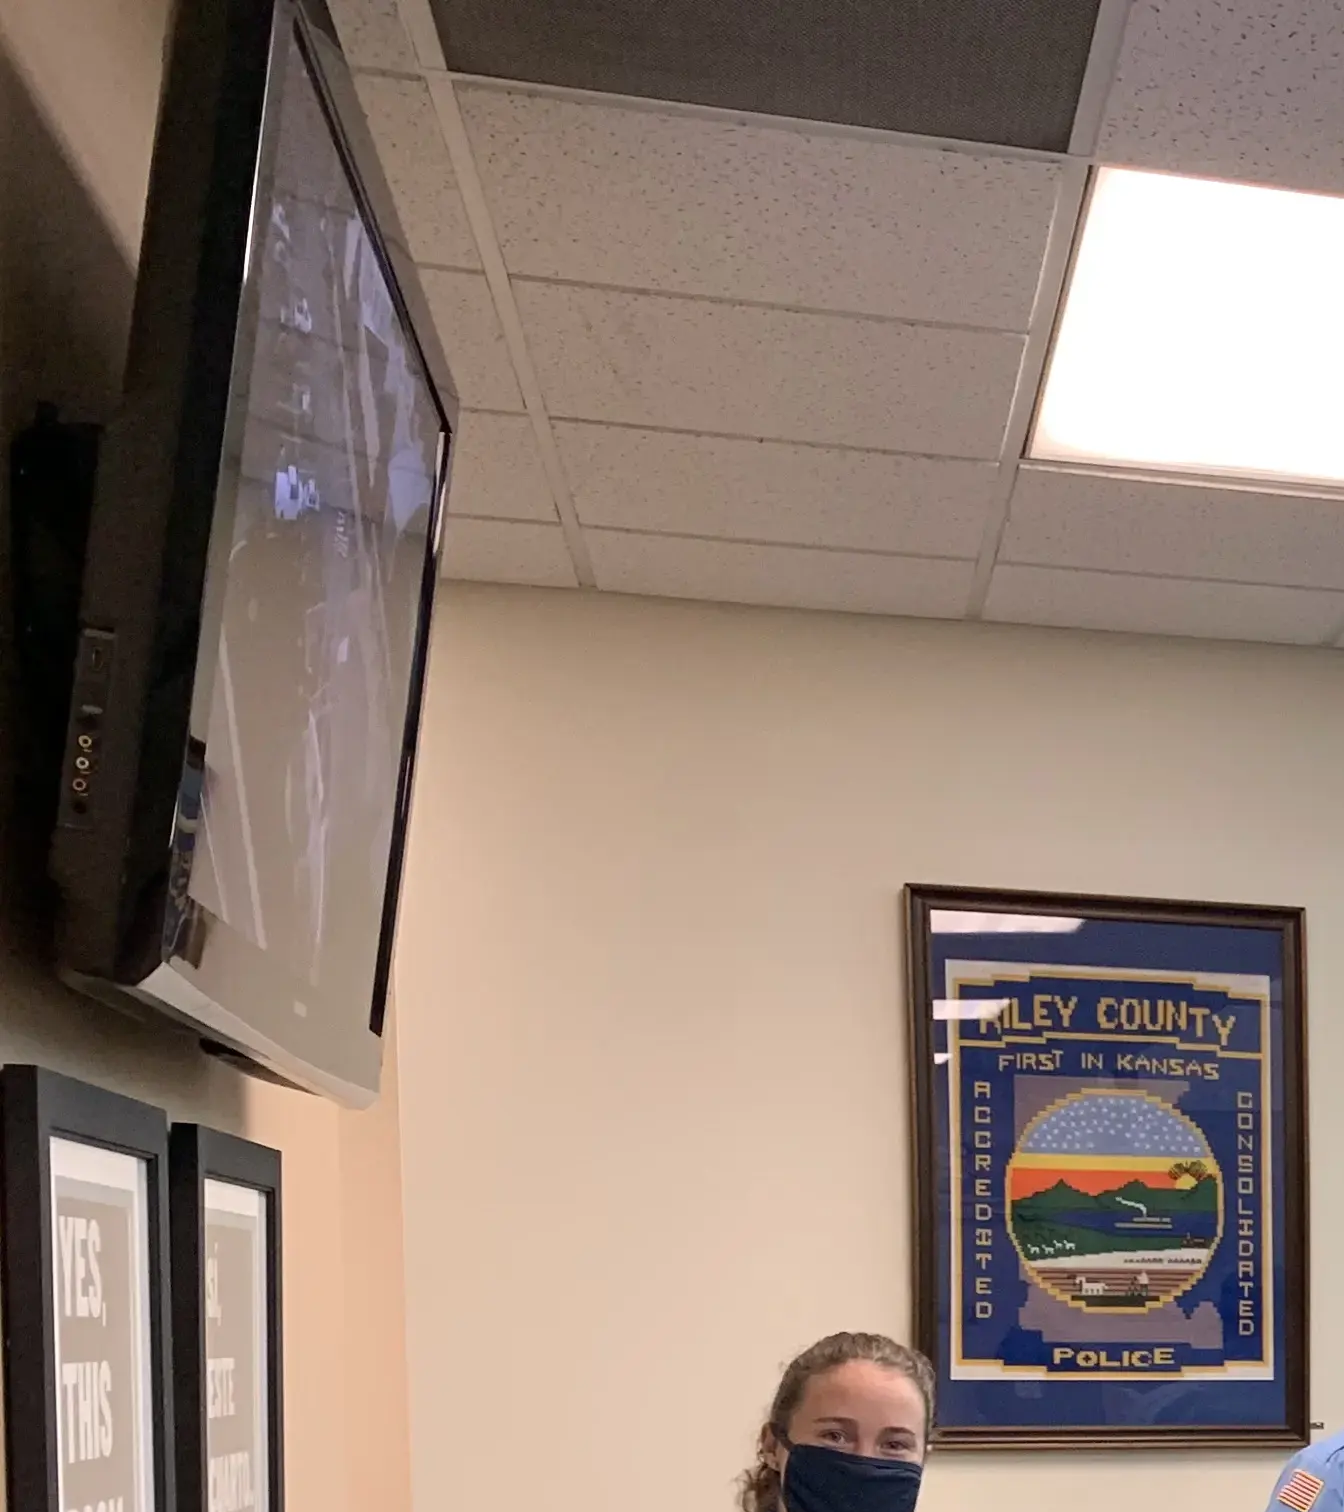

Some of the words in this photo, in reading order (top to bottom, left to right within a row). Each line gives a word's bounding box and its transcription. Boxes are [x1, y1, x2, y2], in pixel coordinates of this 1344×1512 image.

[999, 1050, 1063, 1071] FIRST
[1081, 1052, 1103, 1069] IN
[1117, 1053, 1219, 1080] KANSAS
[1097, 997, 1235, 1046] COUNTY
[974, 1081, 992, 1319] ACCREDITED
[1237, 1092, 1254, 1336] CONSOLIDATED
[59, 1215, 106, 1326] YES,
[1053, 1347, 1174, 1367] POLICE
[62, 1360, 112, 1464] THIS
